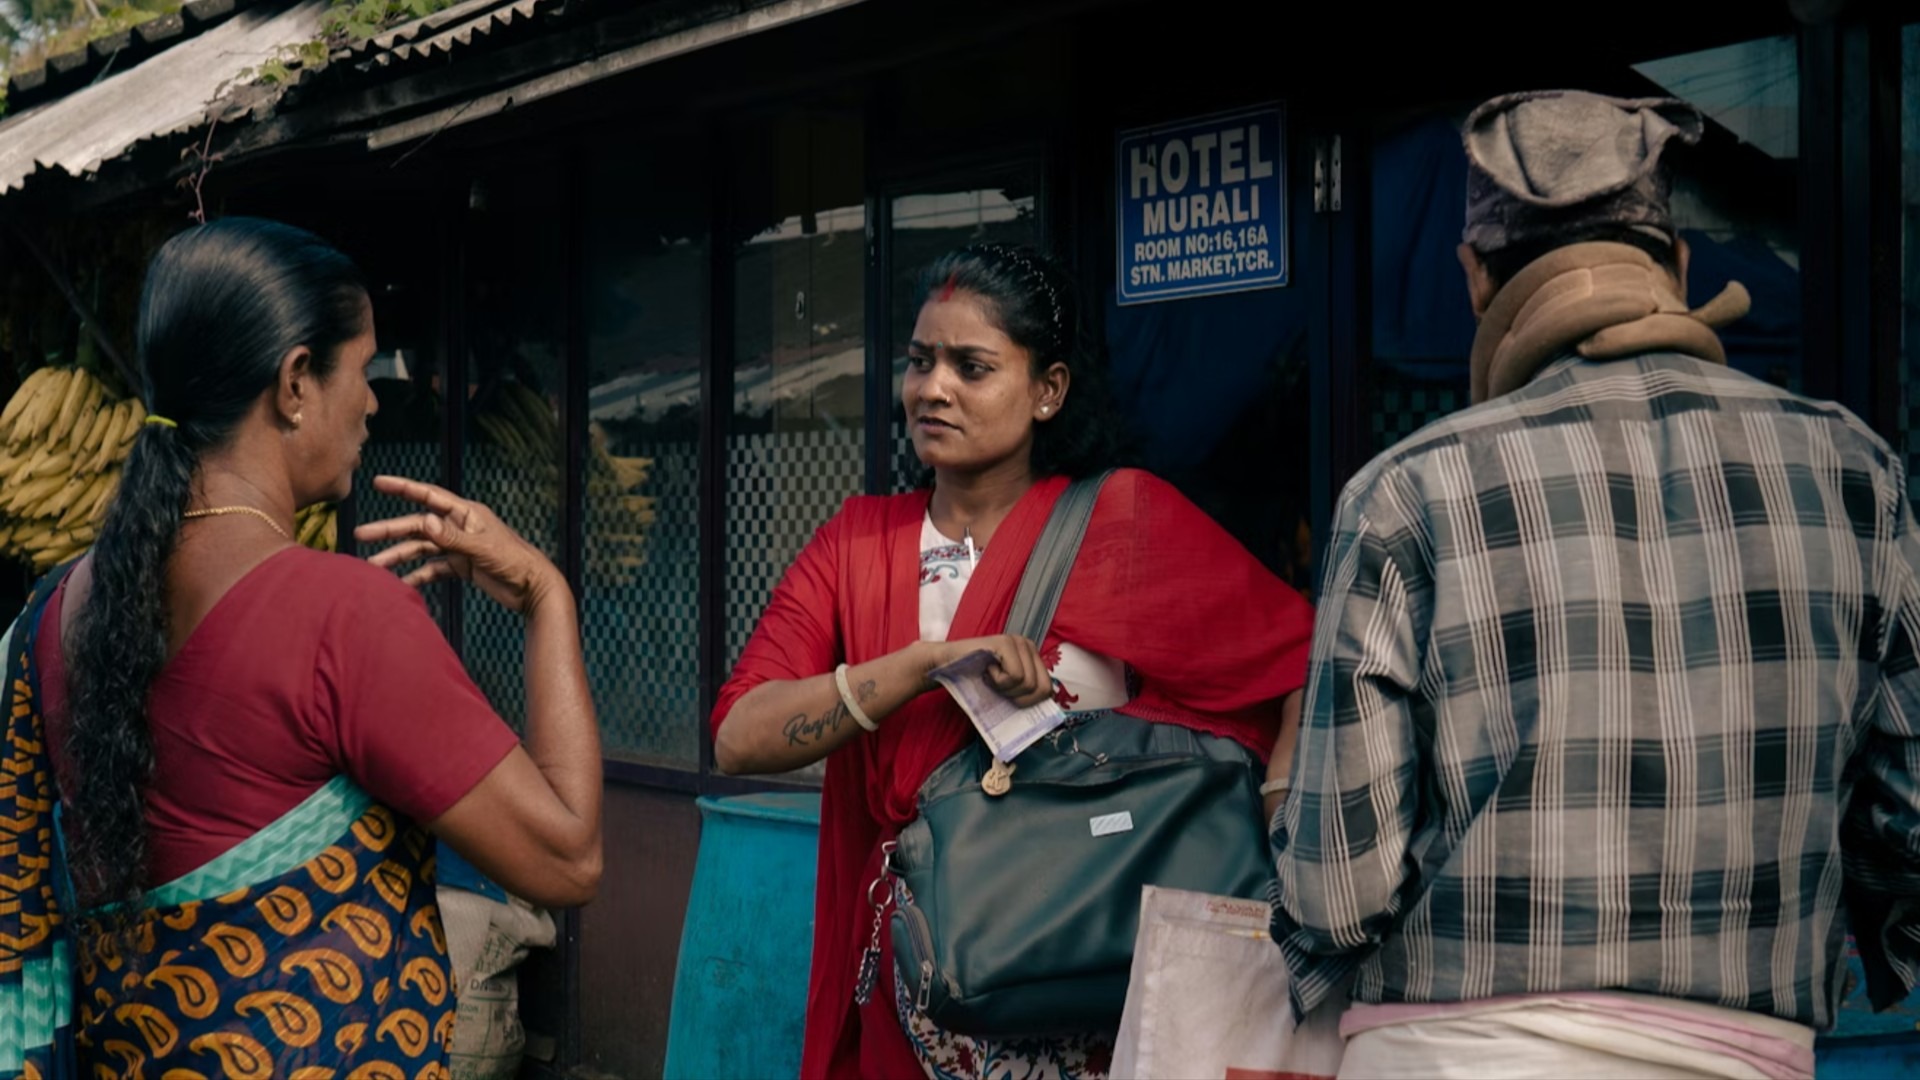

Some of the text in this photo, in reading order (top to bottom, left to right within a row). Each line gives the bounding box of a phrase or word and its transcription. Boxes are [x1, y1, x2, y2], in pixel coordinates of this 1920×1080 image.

[1131, 124, 1273, 199] HOTEL
[1143, 185, 1260, 237] MURALI
[1134, 224, 1269, 262] ROOM NO:16,16A
[1131, 264, 1166, 286] STN.
